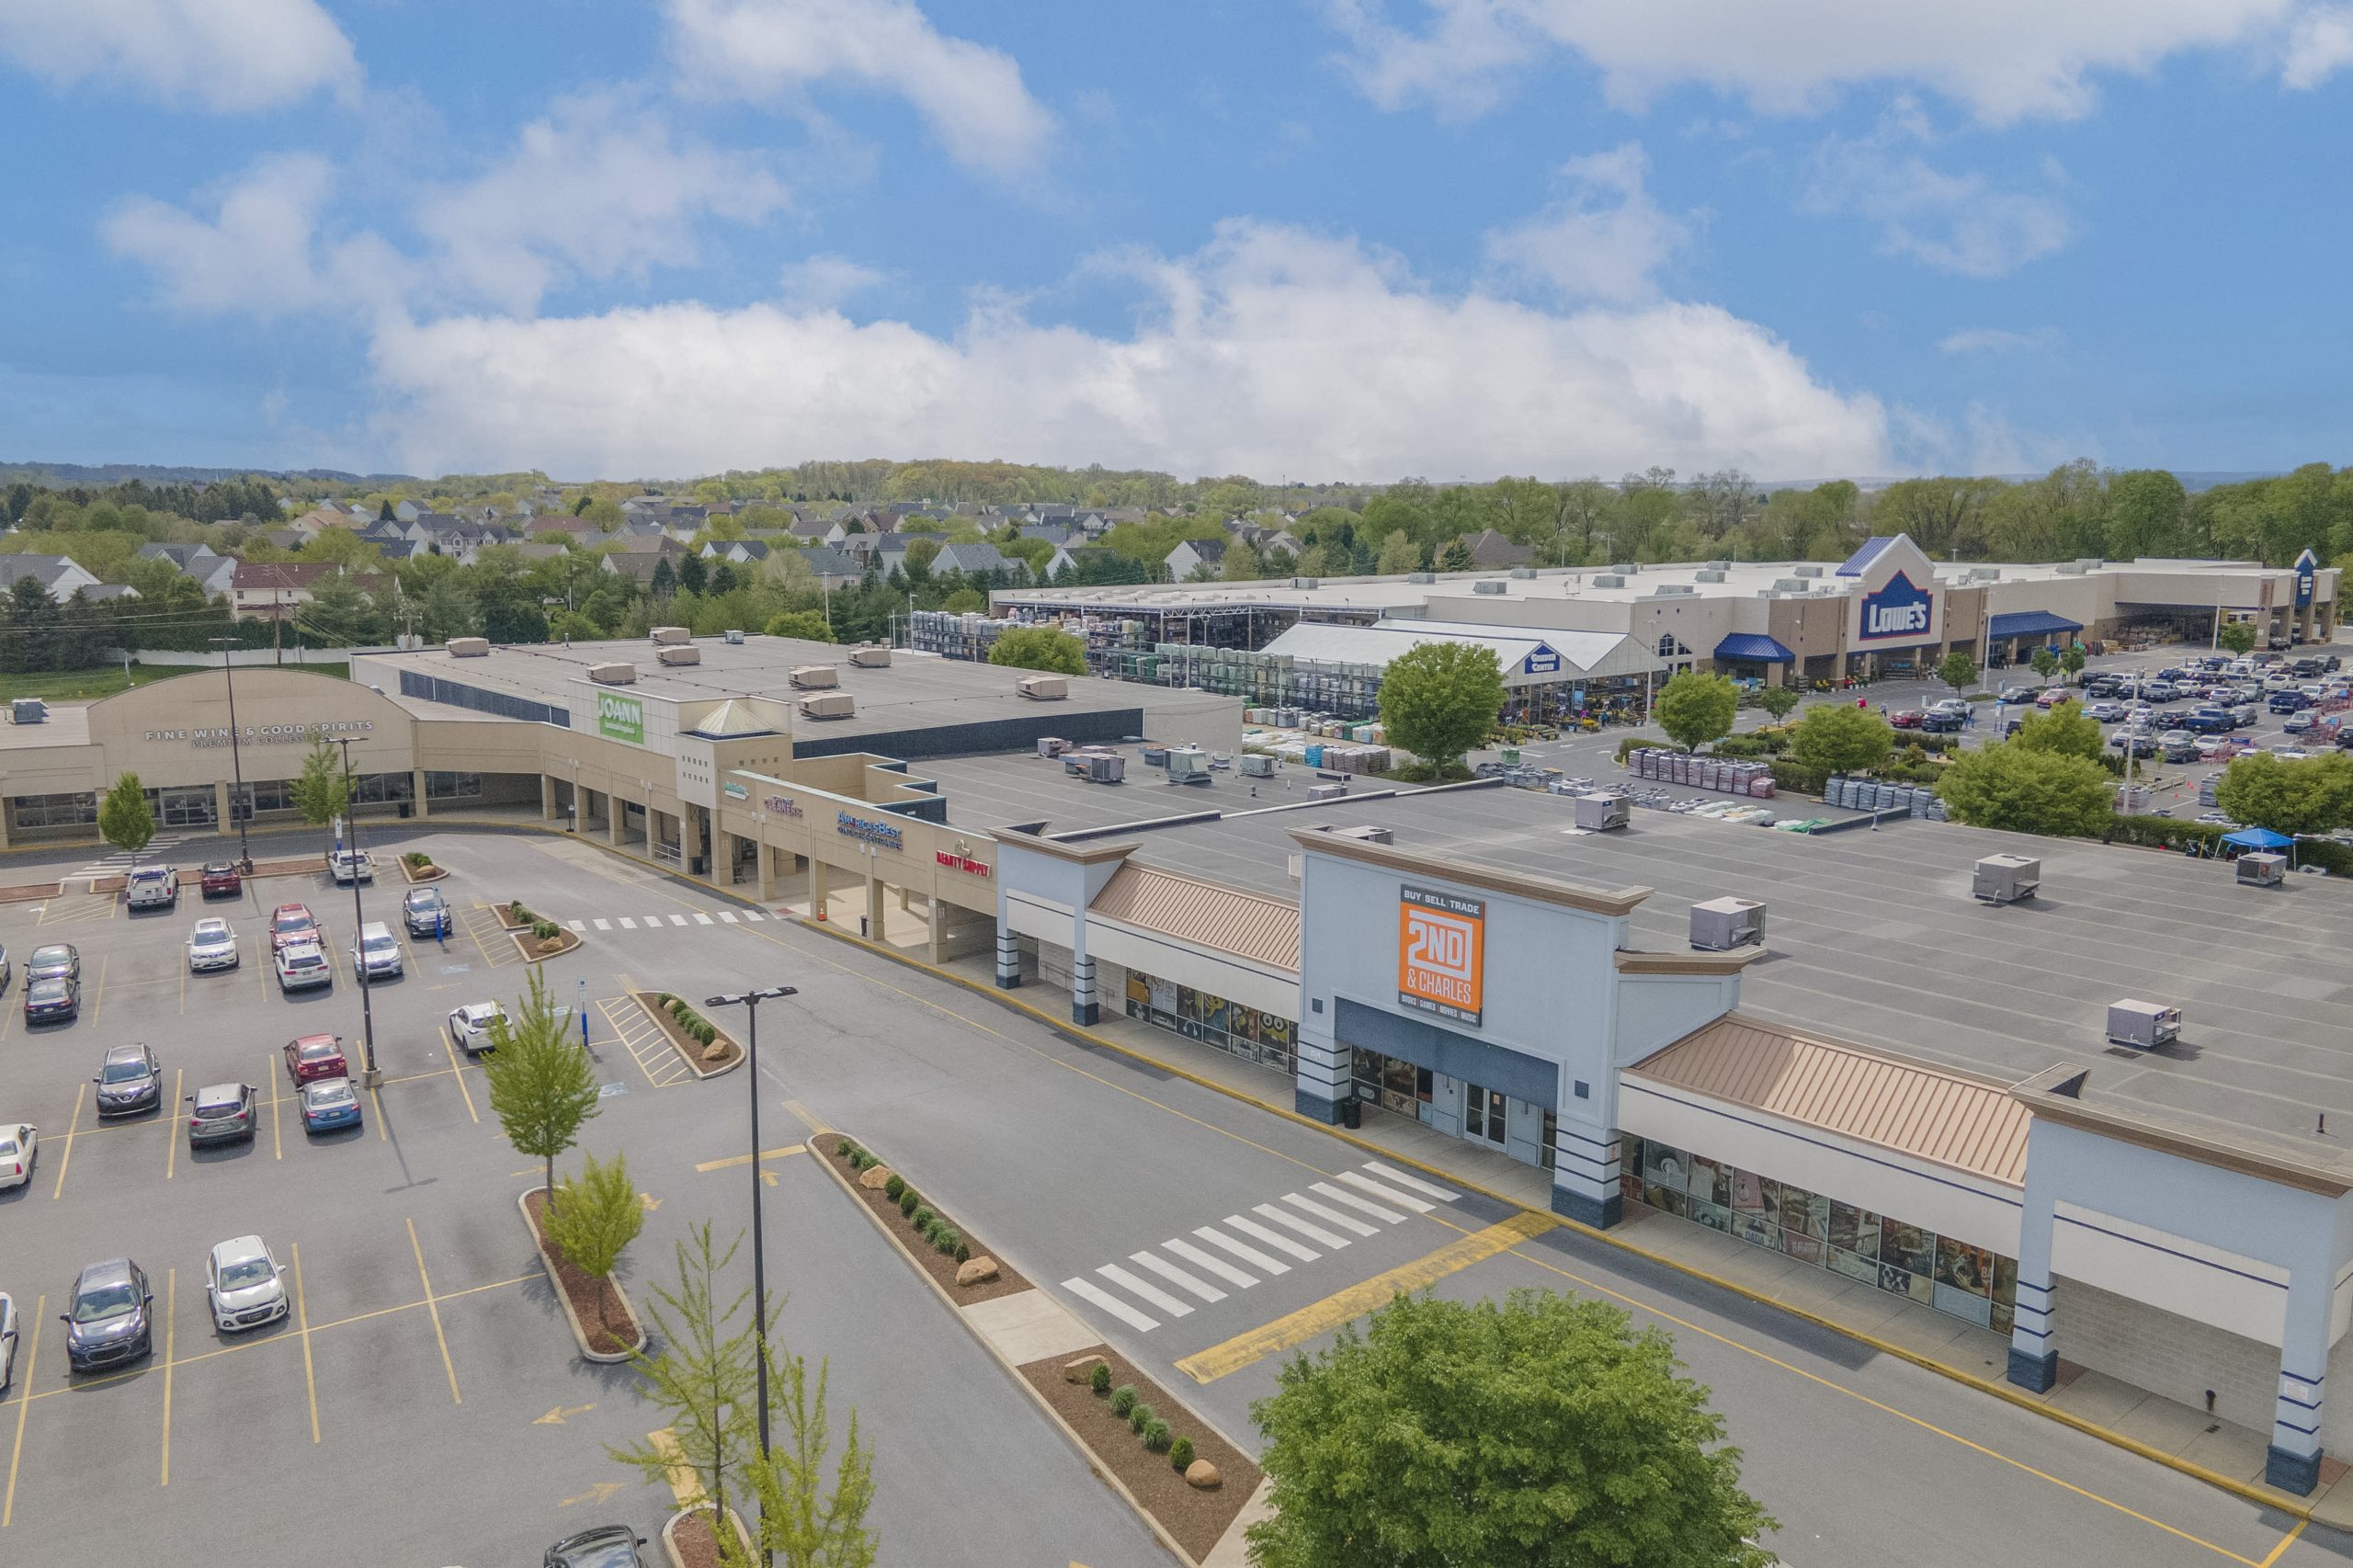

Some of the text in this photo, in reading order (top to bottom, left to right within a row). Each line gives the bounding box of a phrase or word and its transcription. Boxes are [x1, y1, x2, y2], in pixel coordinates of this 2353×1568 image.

[1869, 601, 1927, 633] LOWE'S
[598, 698, 642, 725] JOANN
[145, 730, 187, 741] FINE
[245, 727, 255, 736] &
[260, 724, 305, 735] GOOD
[312, 721, 373, 733] SPIRITS
[937, 850, 991, 877] BEAUTY SUPPLY
[1404, 890, 1480, 915] BUY SELL TRADE
[1408, 919, 1464, 968] 2ND
[1407, 968, 1472, 1005] & CHARLES
